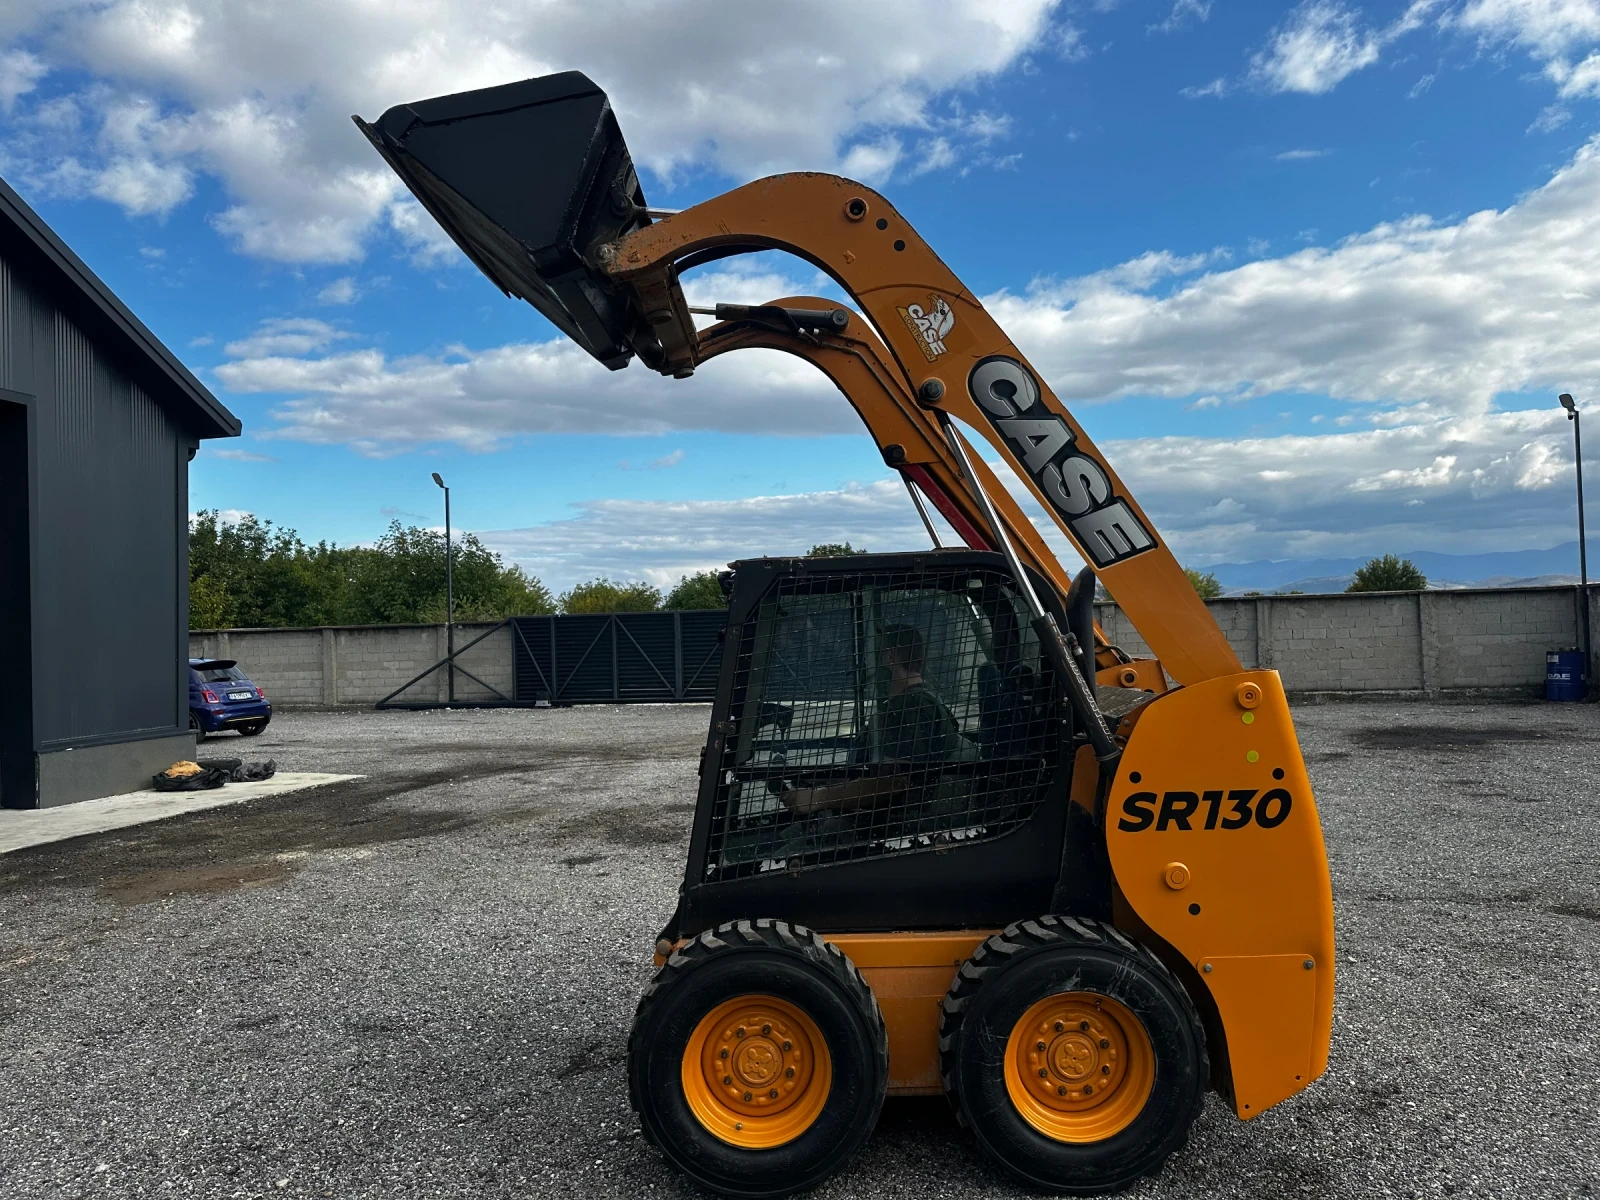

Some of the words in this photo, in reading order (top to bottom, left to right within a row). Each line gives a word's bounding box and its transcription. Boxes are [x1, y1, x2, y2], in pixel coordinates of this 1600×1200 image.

[904, 314, 934, 361] CONSTRUCTION
[907, 303, 948, 356] CASE
[970, 359, 1153, 565] CASE
[1117, 788, 1293, 833] SR130
